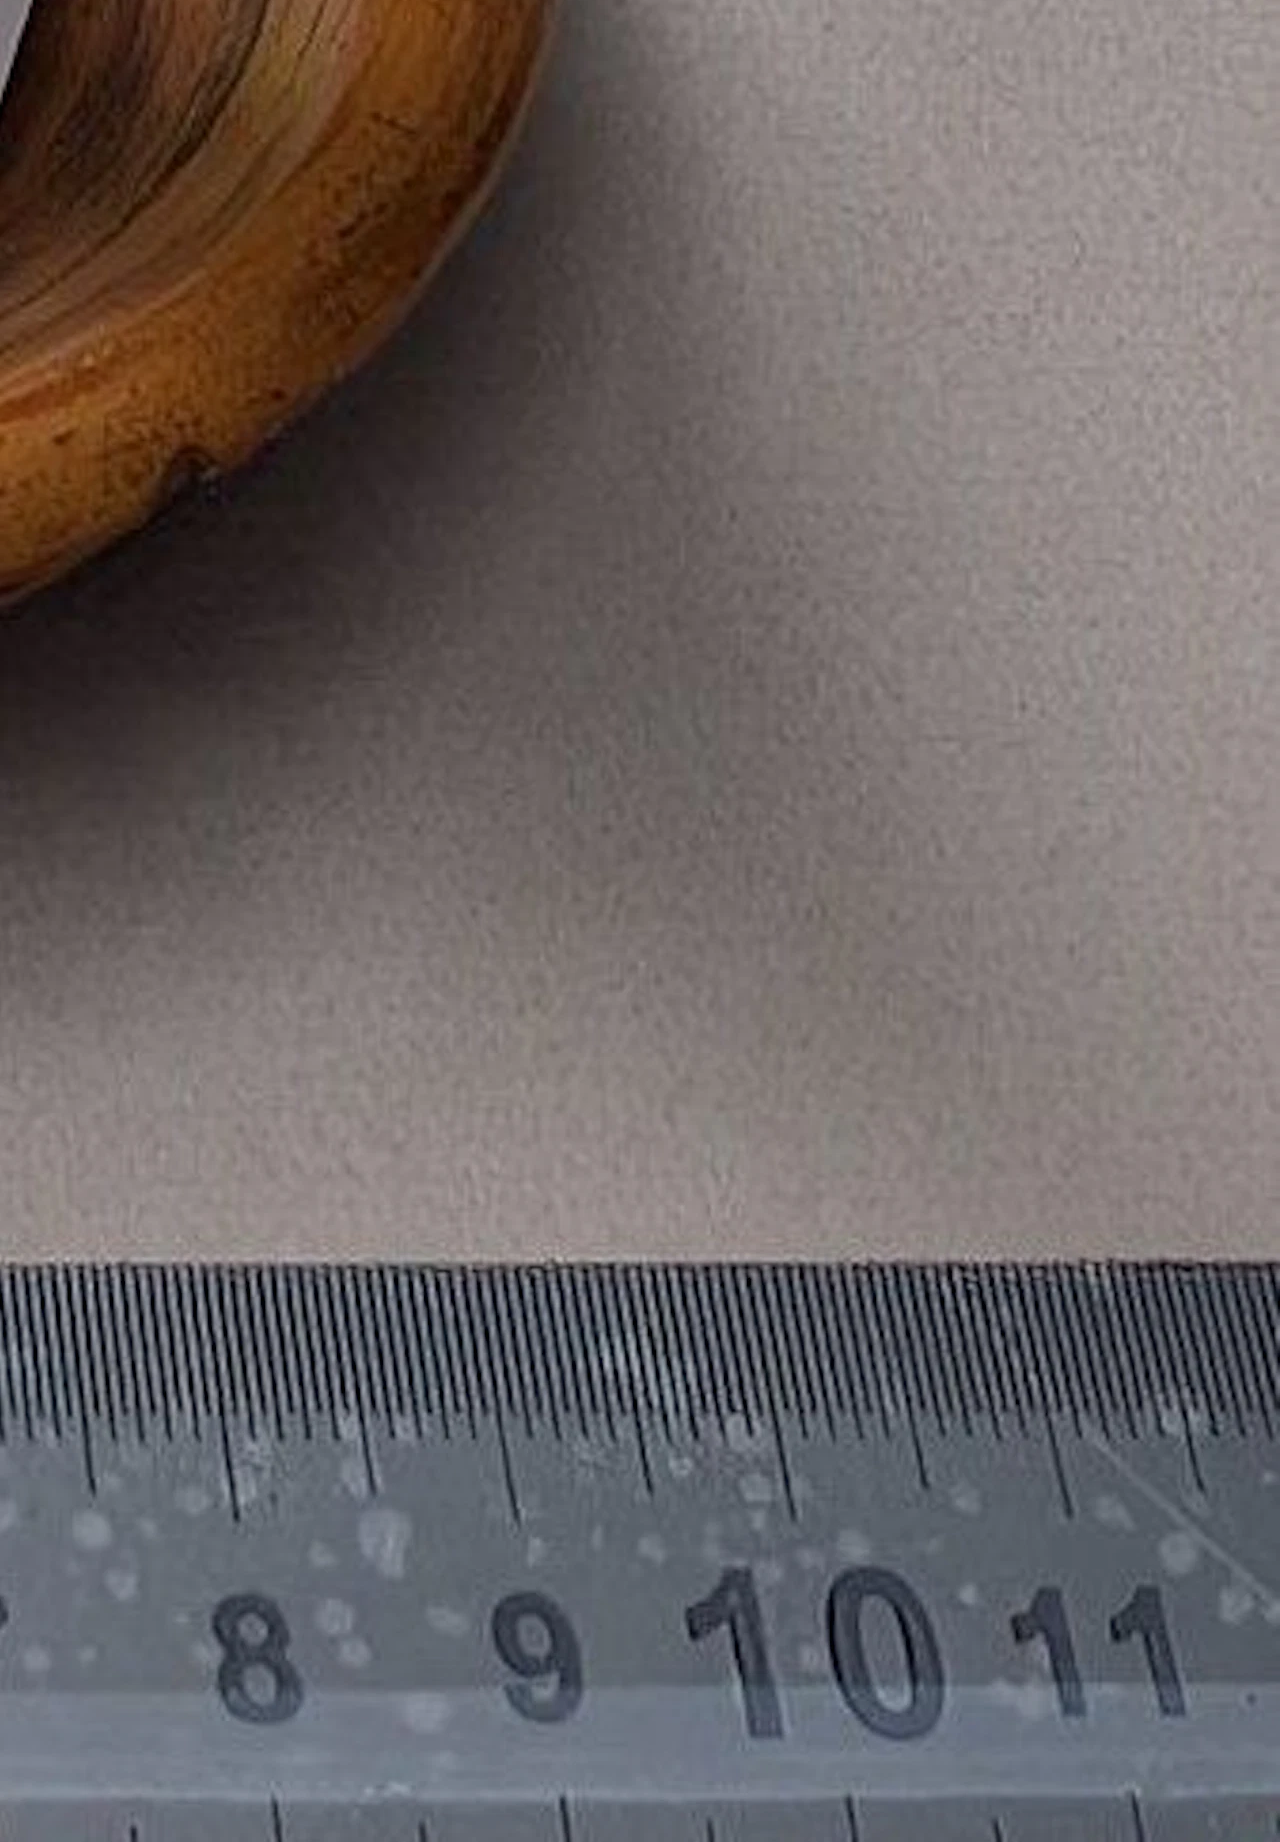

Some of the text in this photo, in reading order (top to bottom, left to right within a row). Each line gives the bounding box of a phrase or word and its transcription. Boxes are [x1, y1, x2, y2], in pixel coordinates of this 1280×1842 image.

[210, 1592, 303, 1724] 8
[490, 1591, 583, 1723] 9
[684, 1565, 945, 1740] 10
[1008, 1583, 1186, 1718] 11
